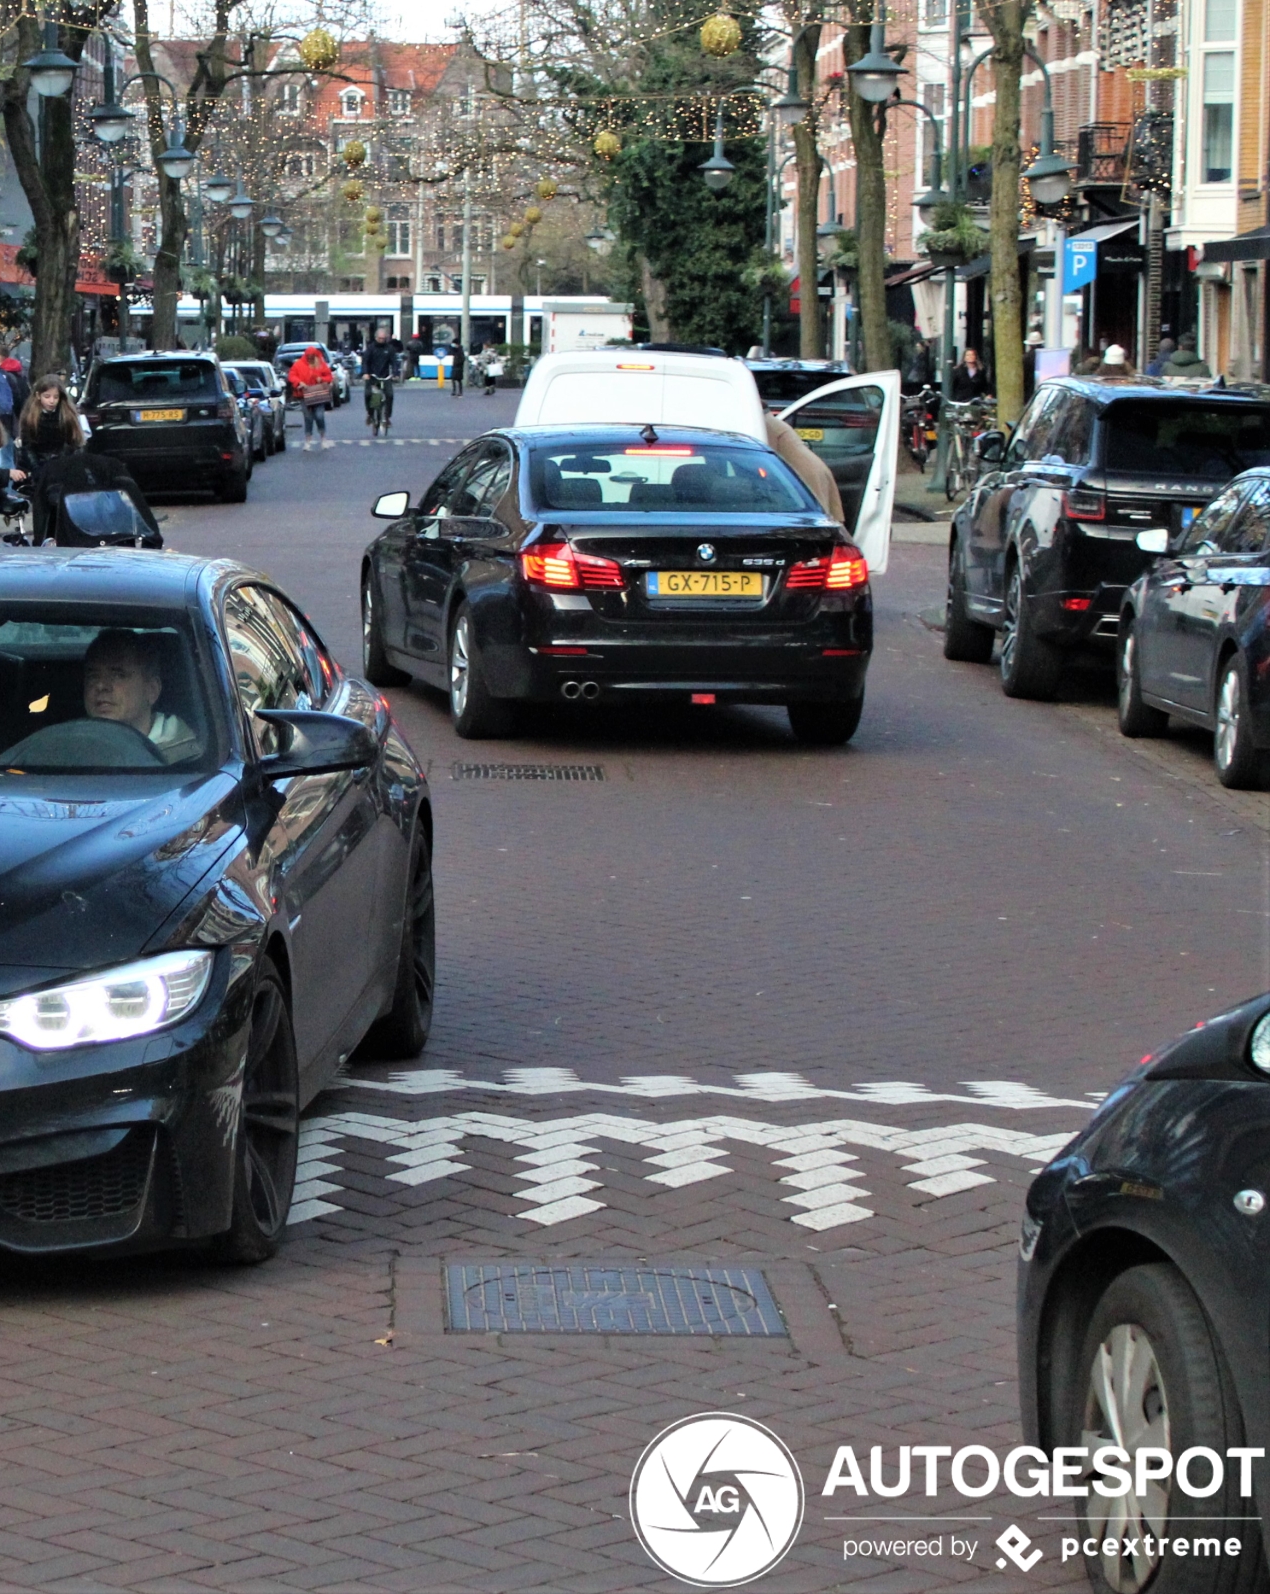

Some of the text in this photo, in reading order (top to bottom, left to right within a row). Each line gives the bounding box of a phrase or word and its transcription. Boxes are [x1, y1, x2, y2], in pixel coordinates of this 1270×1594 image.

[1073, 254, 1087, 276] P
[1155, 483, 1214, 492] RANG
[667, 574, 751, 592] GX-715-P
